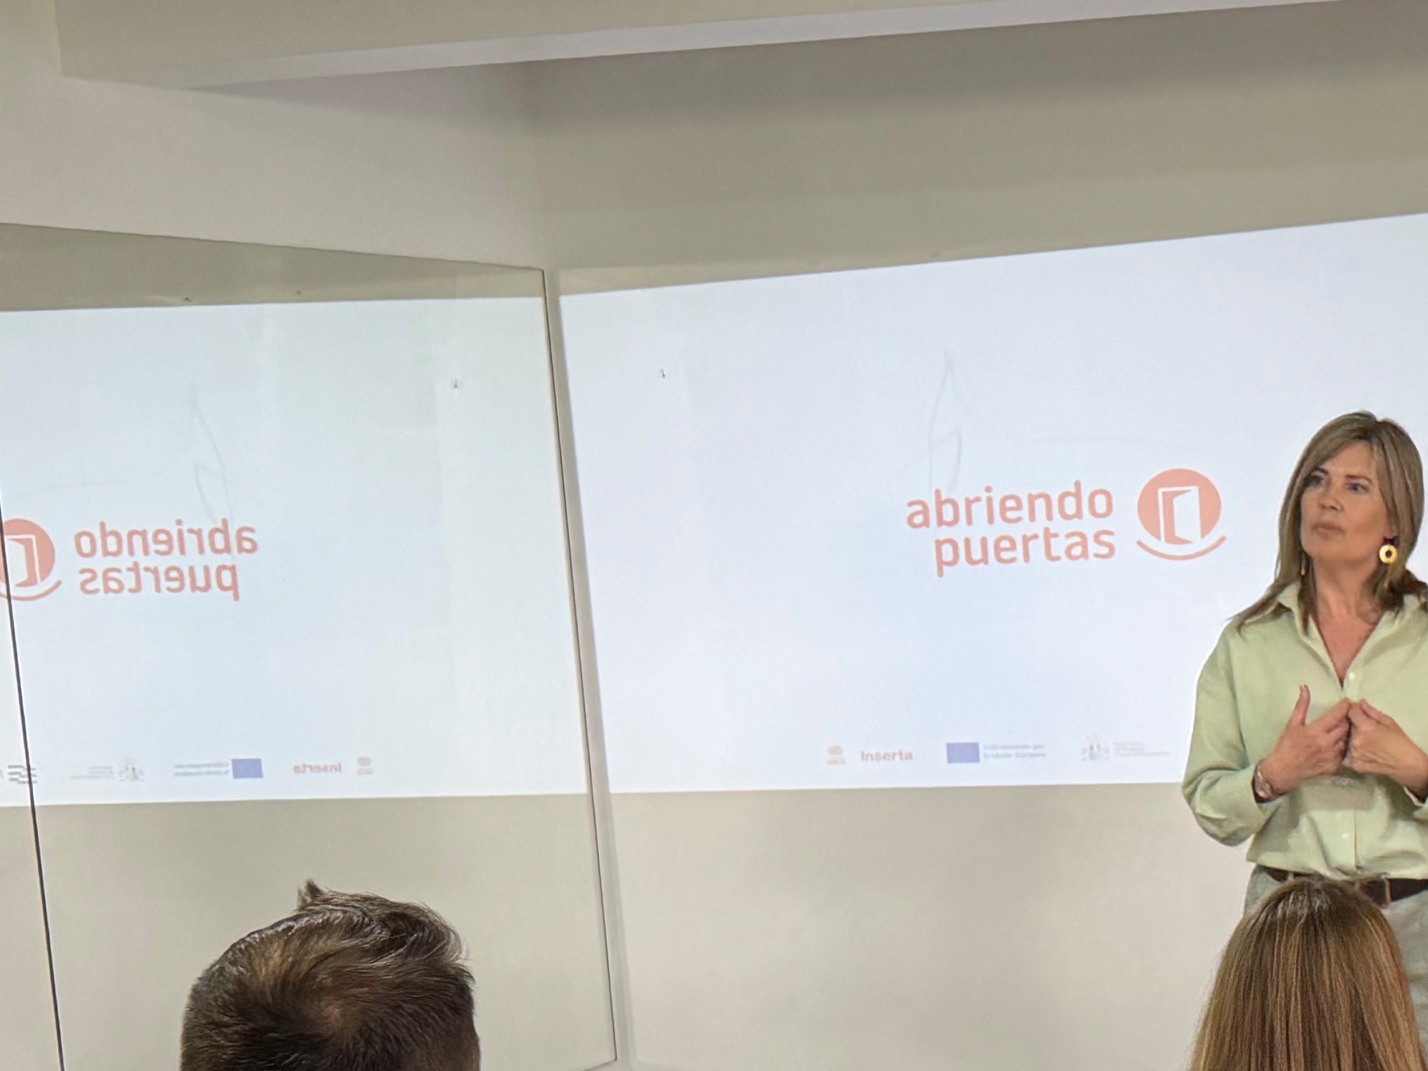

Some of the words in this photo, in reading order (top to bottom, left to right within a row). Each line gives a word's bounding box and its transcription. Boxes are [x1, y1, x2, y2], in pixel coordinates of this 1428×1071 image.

[906, 479, 1115, 529] abriendo
[934, 526, 1117, 578] puertas
[860, 748, 914, 763] Inserta
